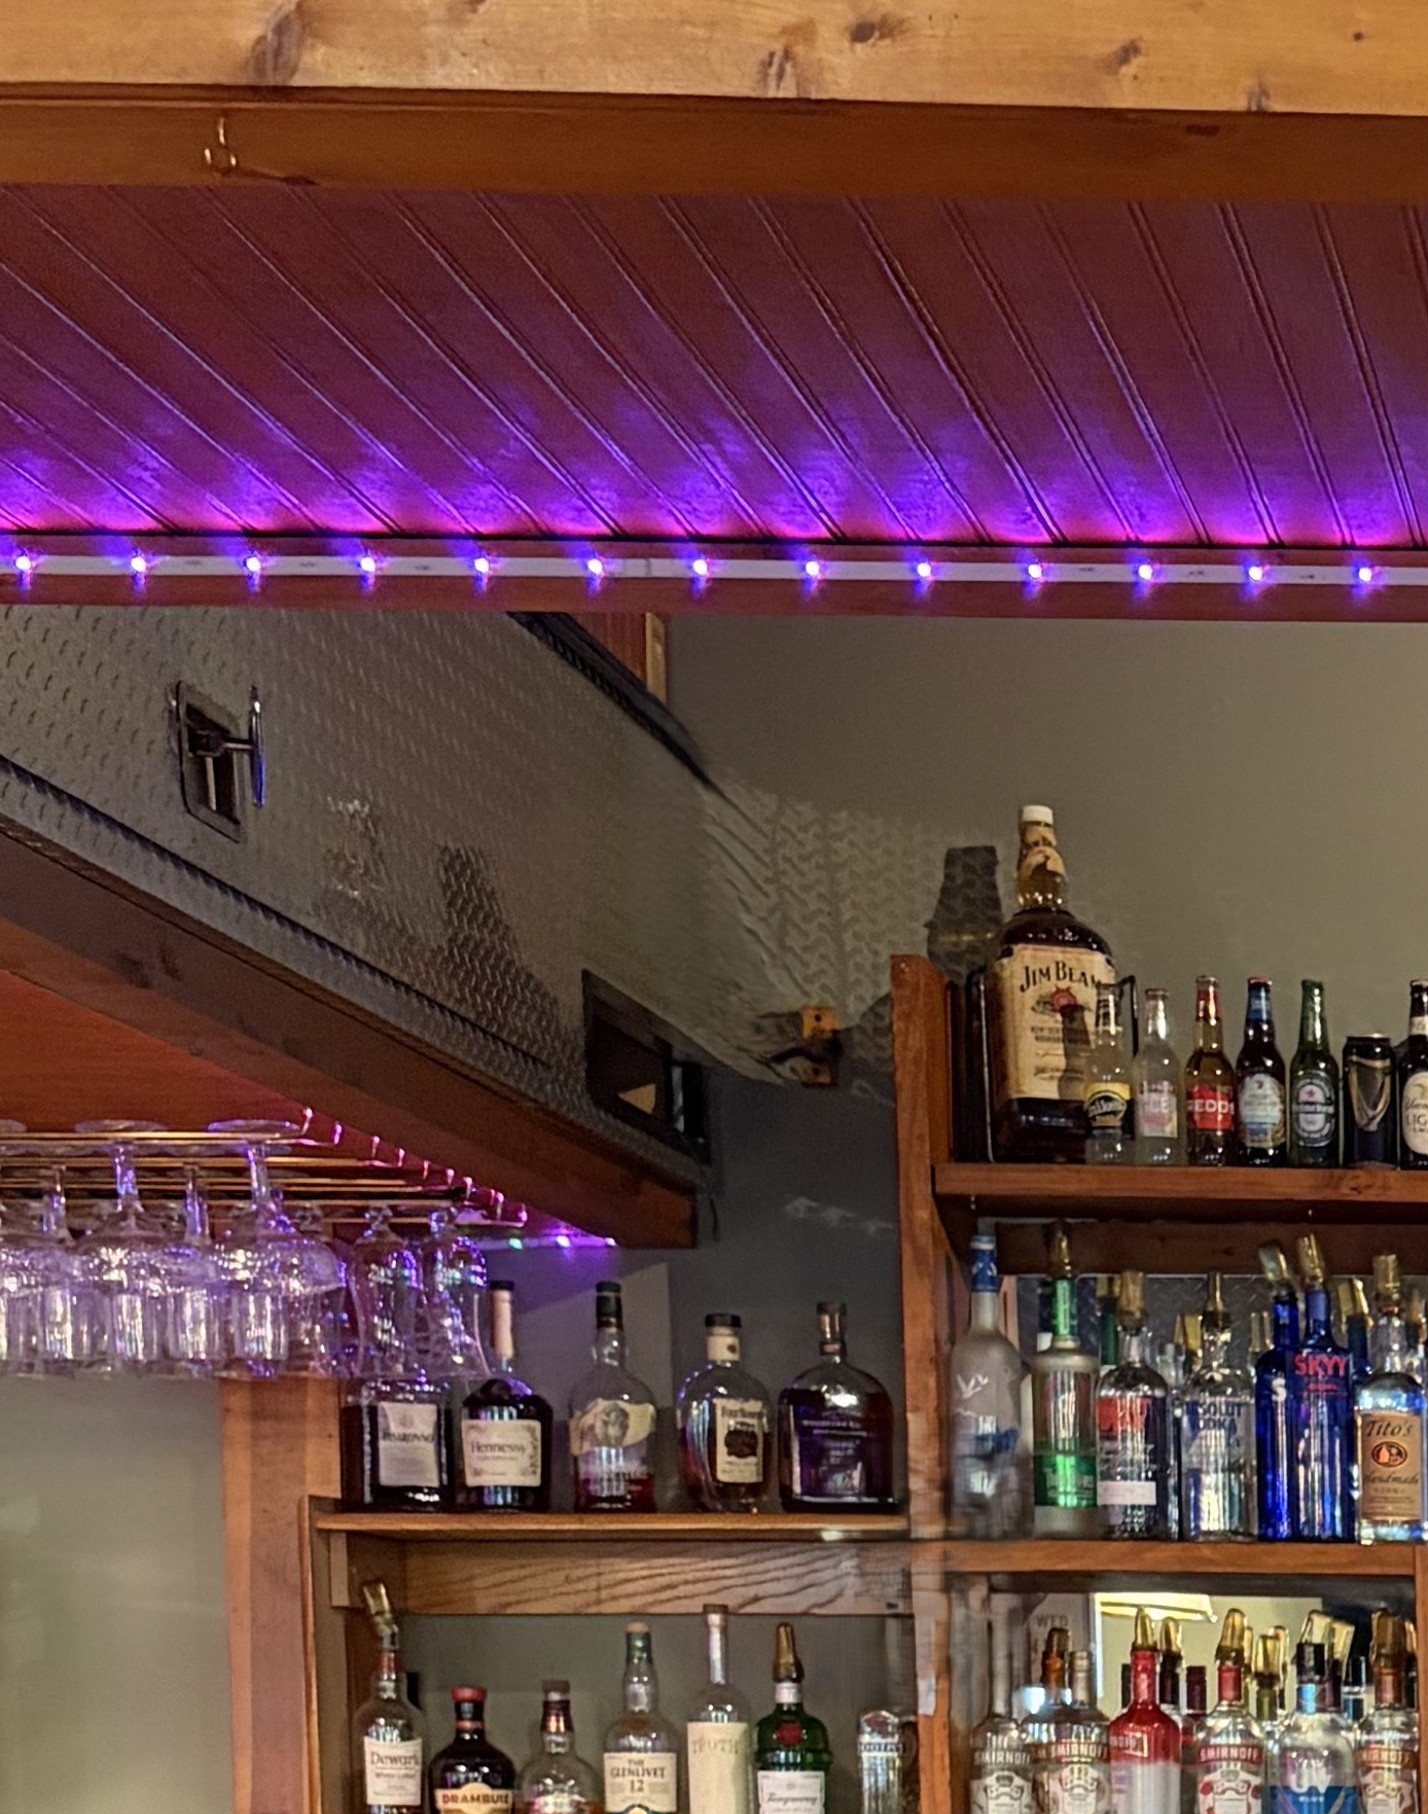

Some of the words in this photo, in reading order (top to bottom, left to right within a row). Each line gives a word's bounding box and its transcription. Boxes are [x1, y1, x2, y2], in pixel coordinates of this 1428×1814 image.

[1019, 965, 1051, 993] JIM
[1292, 1353, 1348, 1376] SKYY
[1365, 1419, 1414, 1438] Tito's
[470, 1441, 527, 1455] Hennessy
[974, 1751, 1030, 1766] SMIRNOFF
[1200, 1746, 1259, 1762] SMIRNOFF
[610, 1767, 666, 1778] GLENLIVET
[1291, 1765, 1332, 1794] UV
[629, 1780, 645, 1792] 12
[441, 1794, 509, 1804] DRAMBUIE
